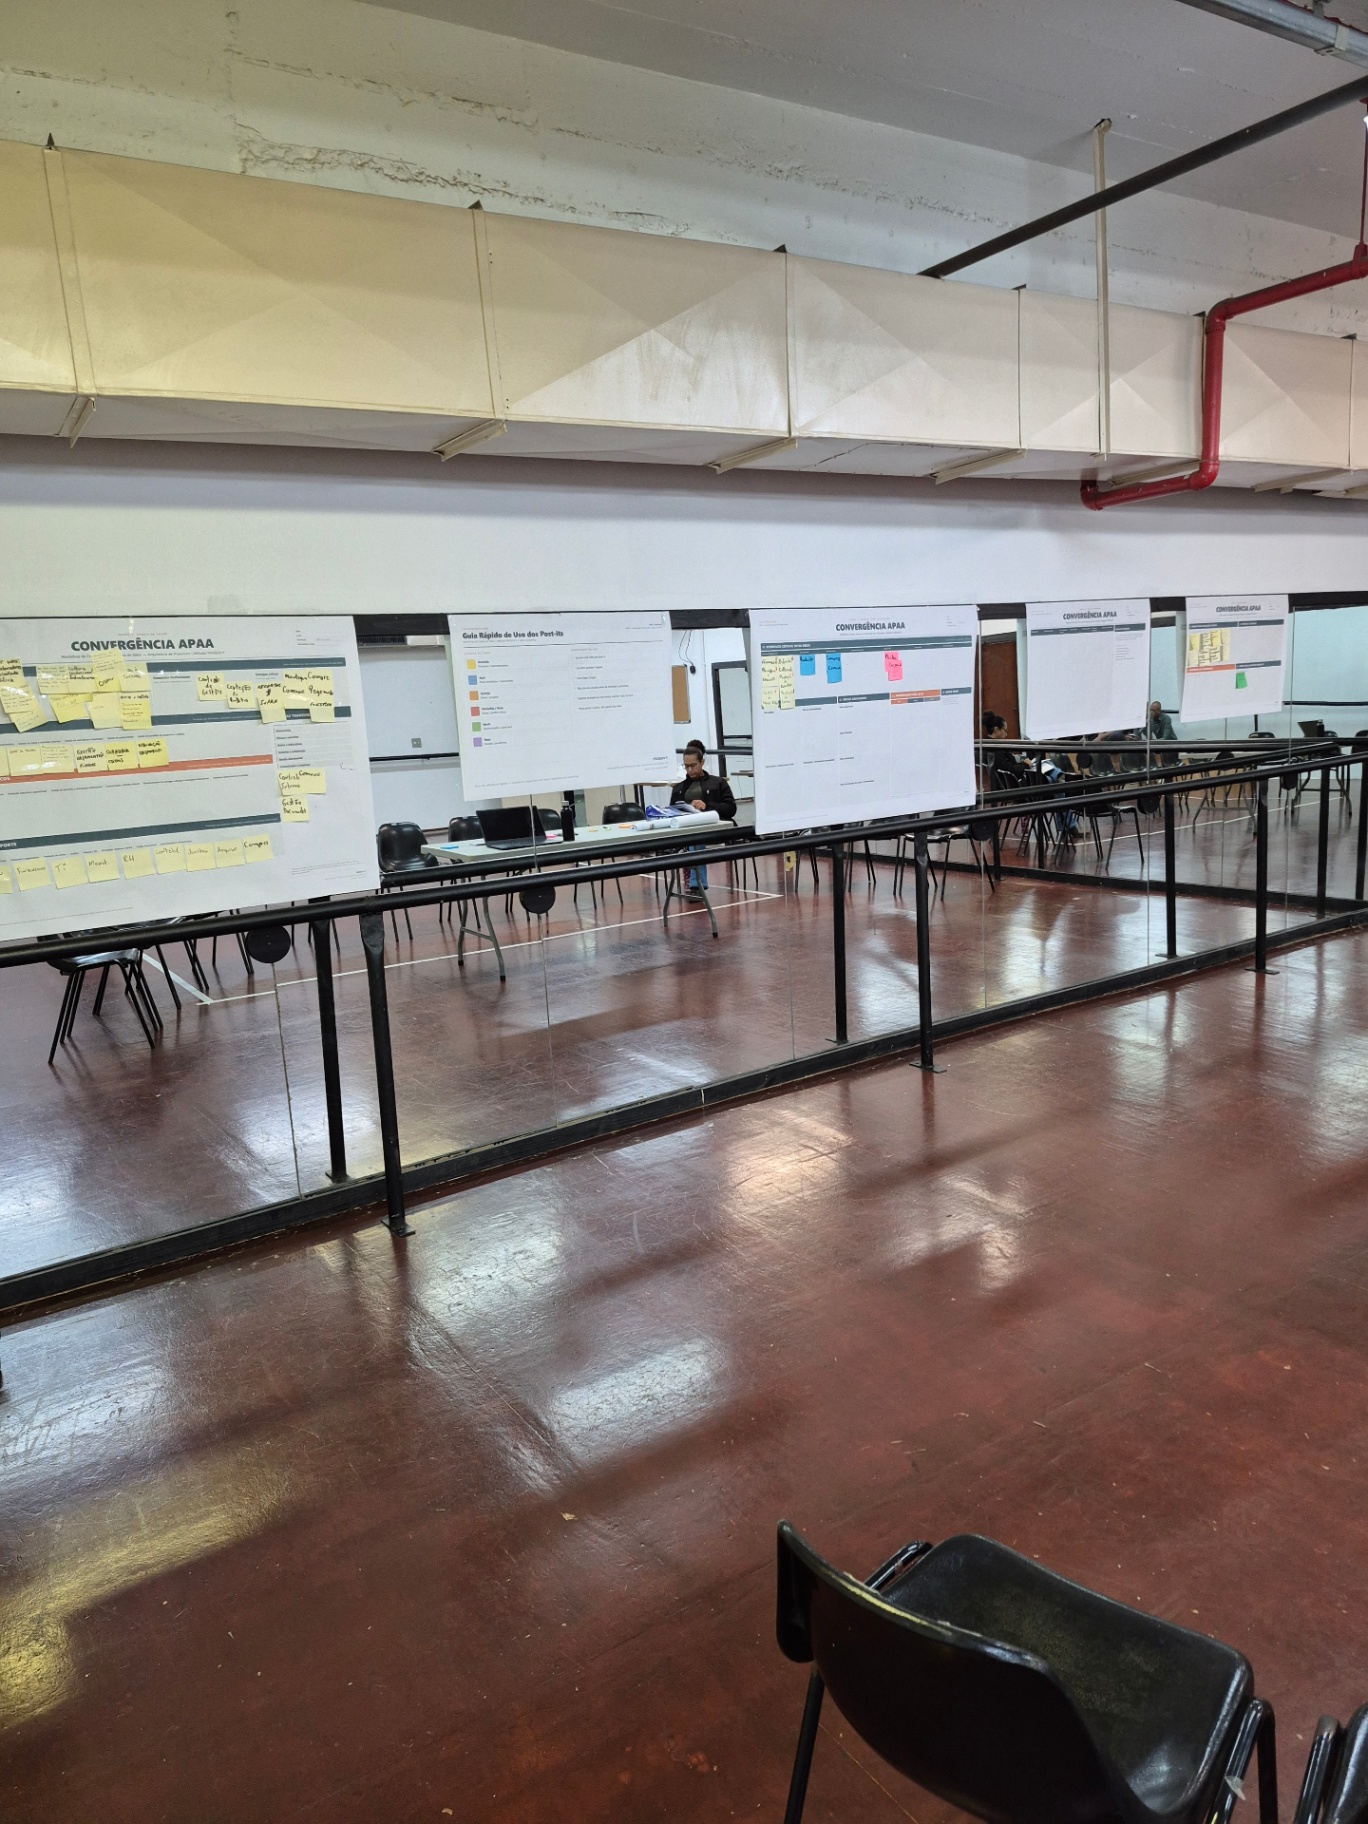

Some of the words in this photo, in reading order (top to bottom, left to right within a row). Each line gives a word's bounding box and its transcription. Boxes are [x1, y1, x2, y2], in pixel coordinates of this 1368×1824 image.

[1063, 611, 1102, 620] CONVERGÊNCIA
[836, 621, 887, 632] CONVERGÊNCIA
[888, 622, 905, 630] APAA
[479, 631, 502, 641] Rápido
[71, 637, 176, 651] CONVERGÊNCIA
[178, 638, 215, 649] APAA
